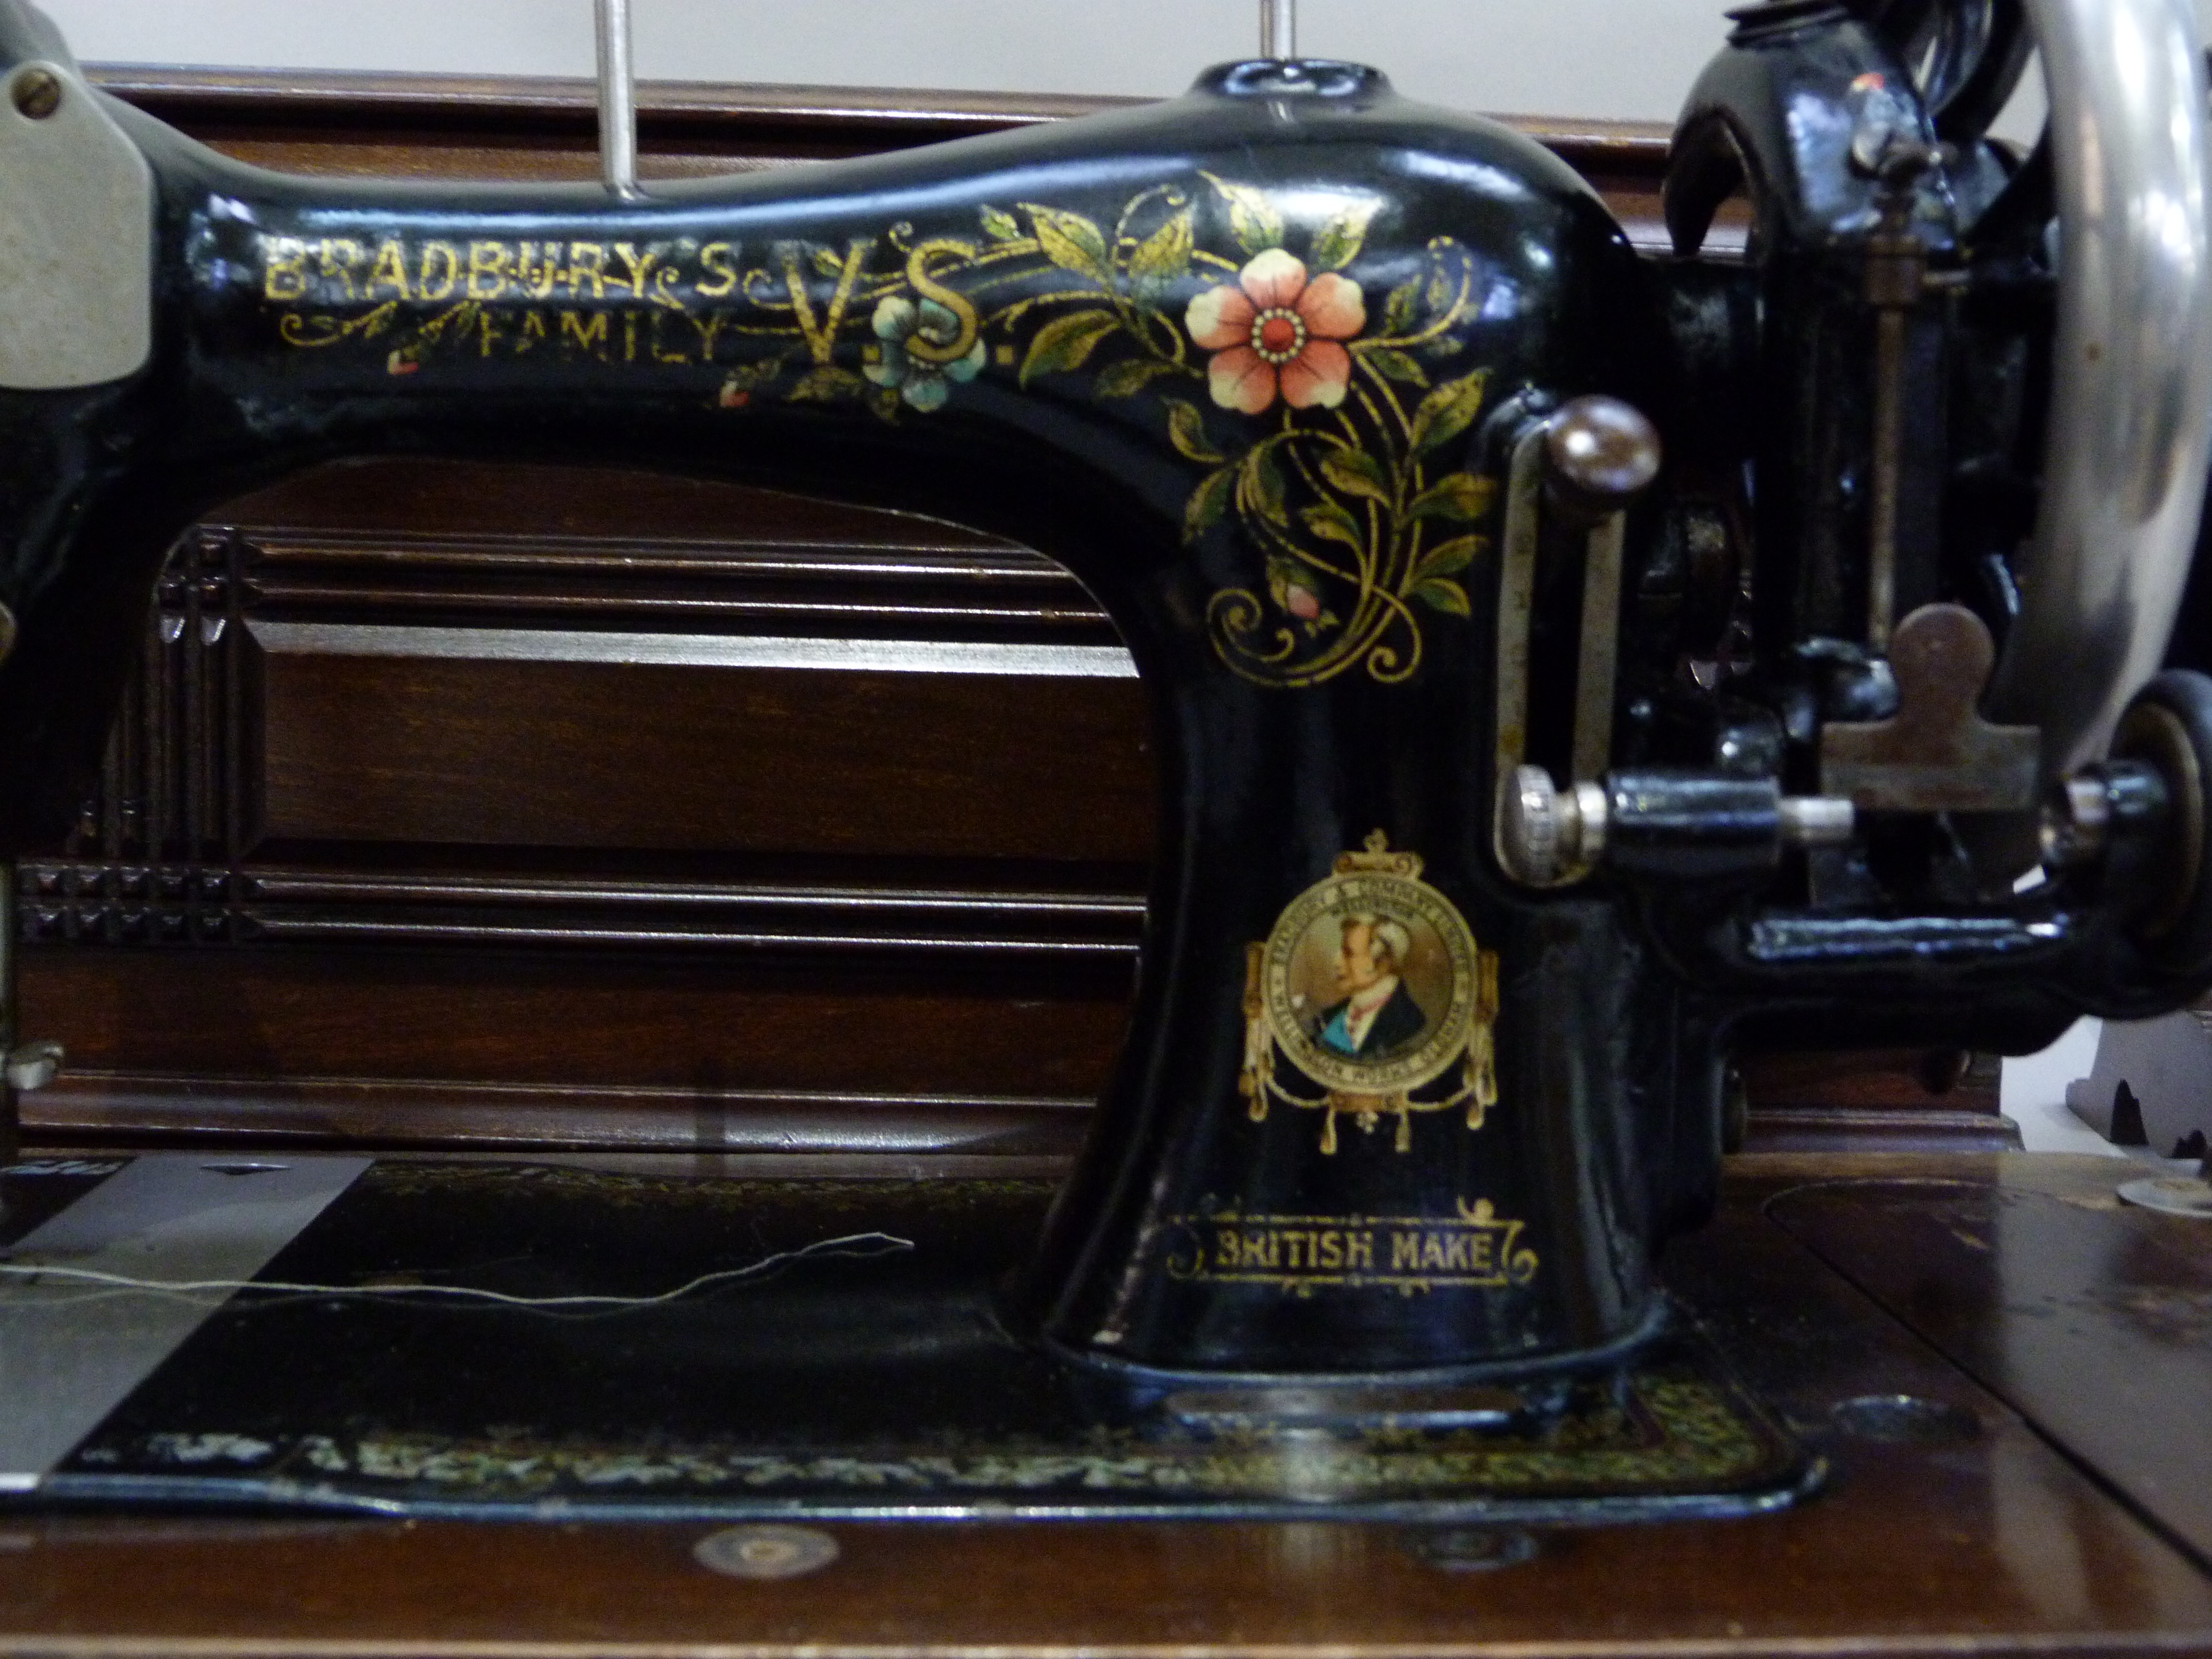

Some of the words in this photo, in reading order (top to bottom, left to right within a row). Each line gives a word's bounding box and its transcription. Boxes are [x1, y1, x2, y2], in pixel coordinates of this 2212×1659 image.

[478, 309, 728, 359] FAMILY
[1216, 1230, 1374, 1269] BRITISH
[1391, 1231, 1492, 1270] MAKE
